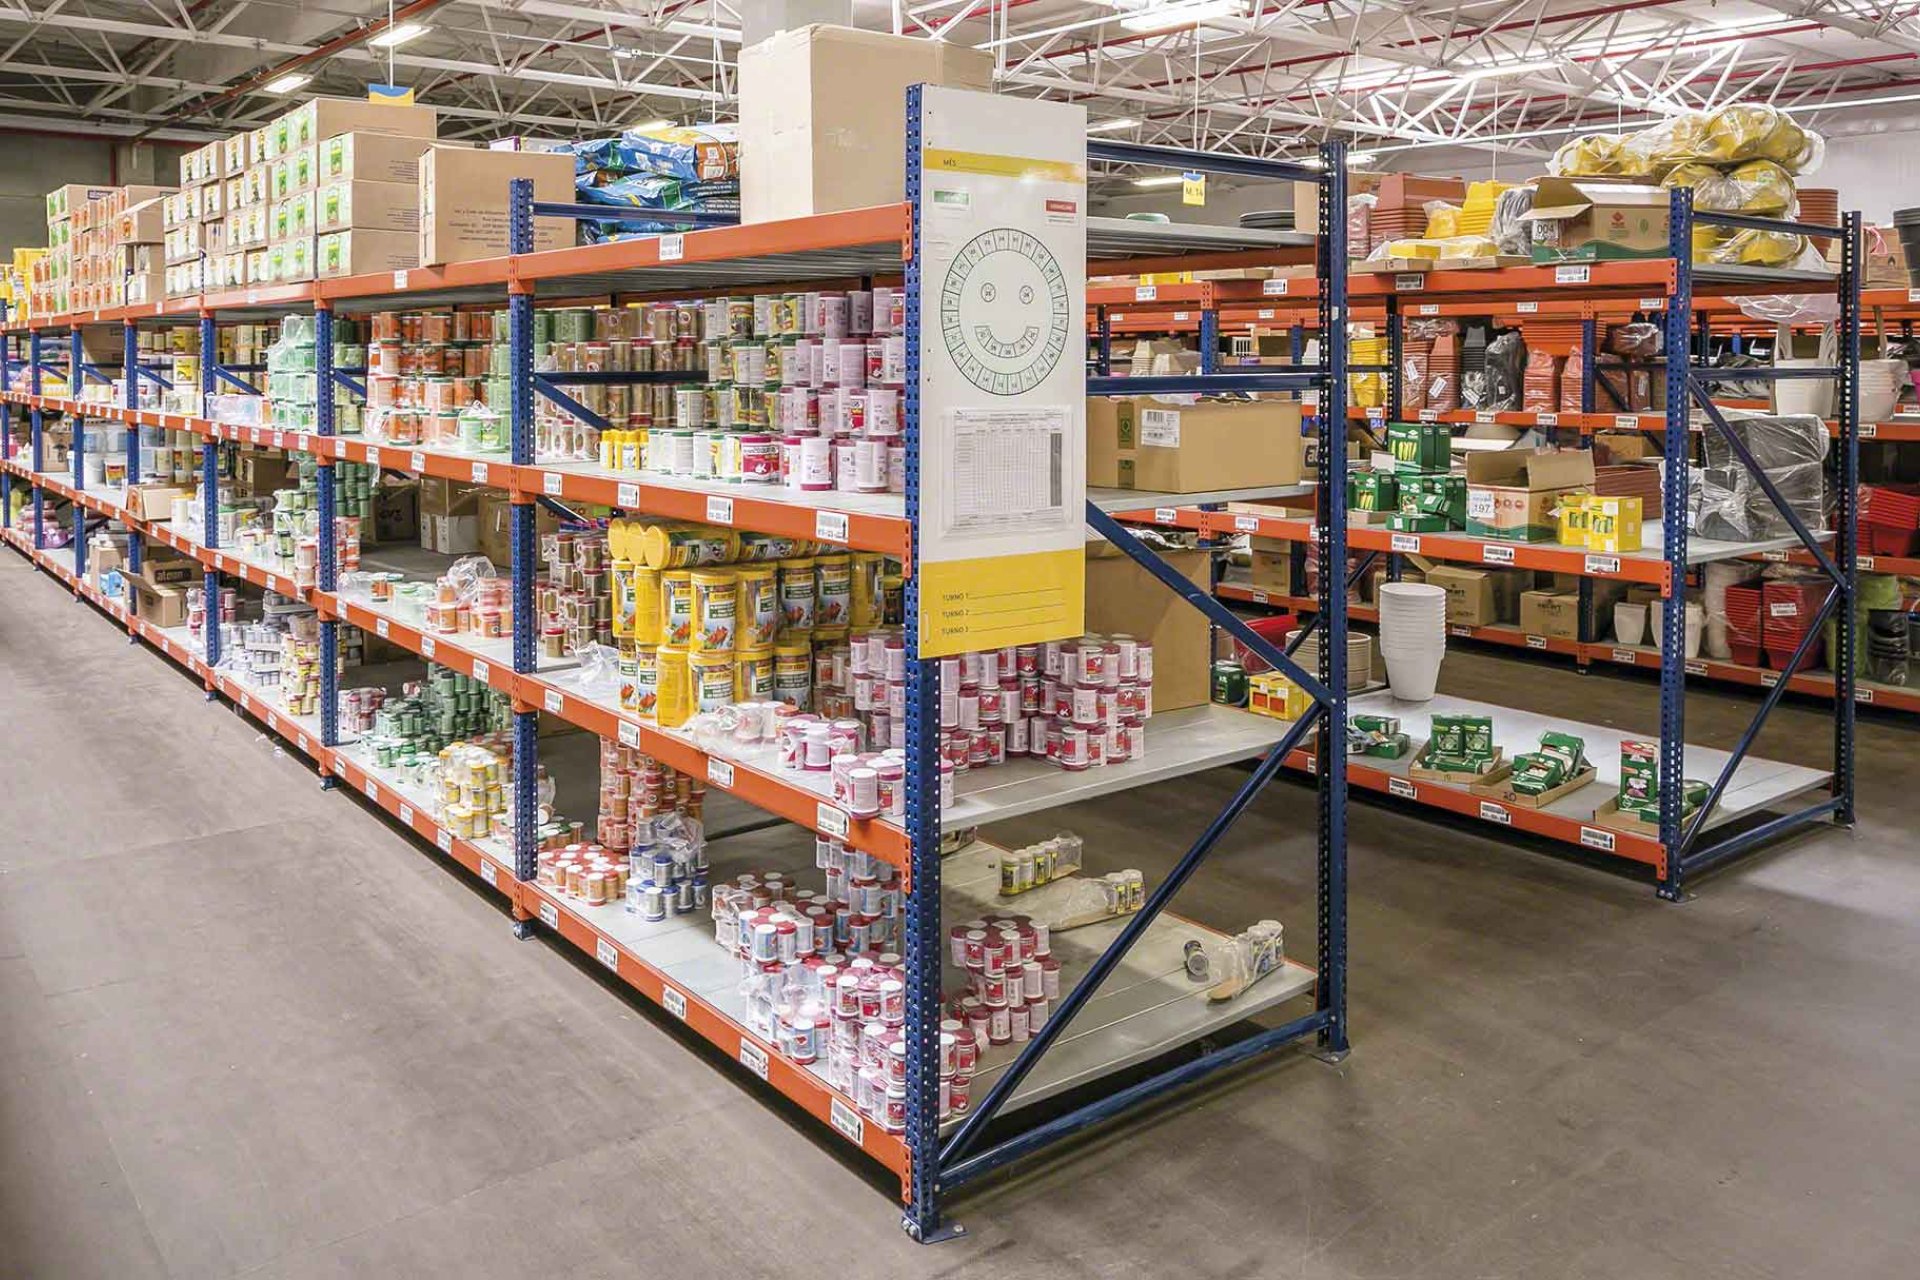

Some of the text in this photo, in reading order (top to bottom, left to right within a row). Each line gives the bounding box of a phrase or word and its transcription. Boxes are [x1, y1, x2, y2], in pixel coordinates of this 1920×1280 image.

[1537, 223, 1555, 234] 004
[942, 592, 964, 601] TURNO
[942, 609, 964, 618] TURNO
[942, 626, 964, 635] TURNO
